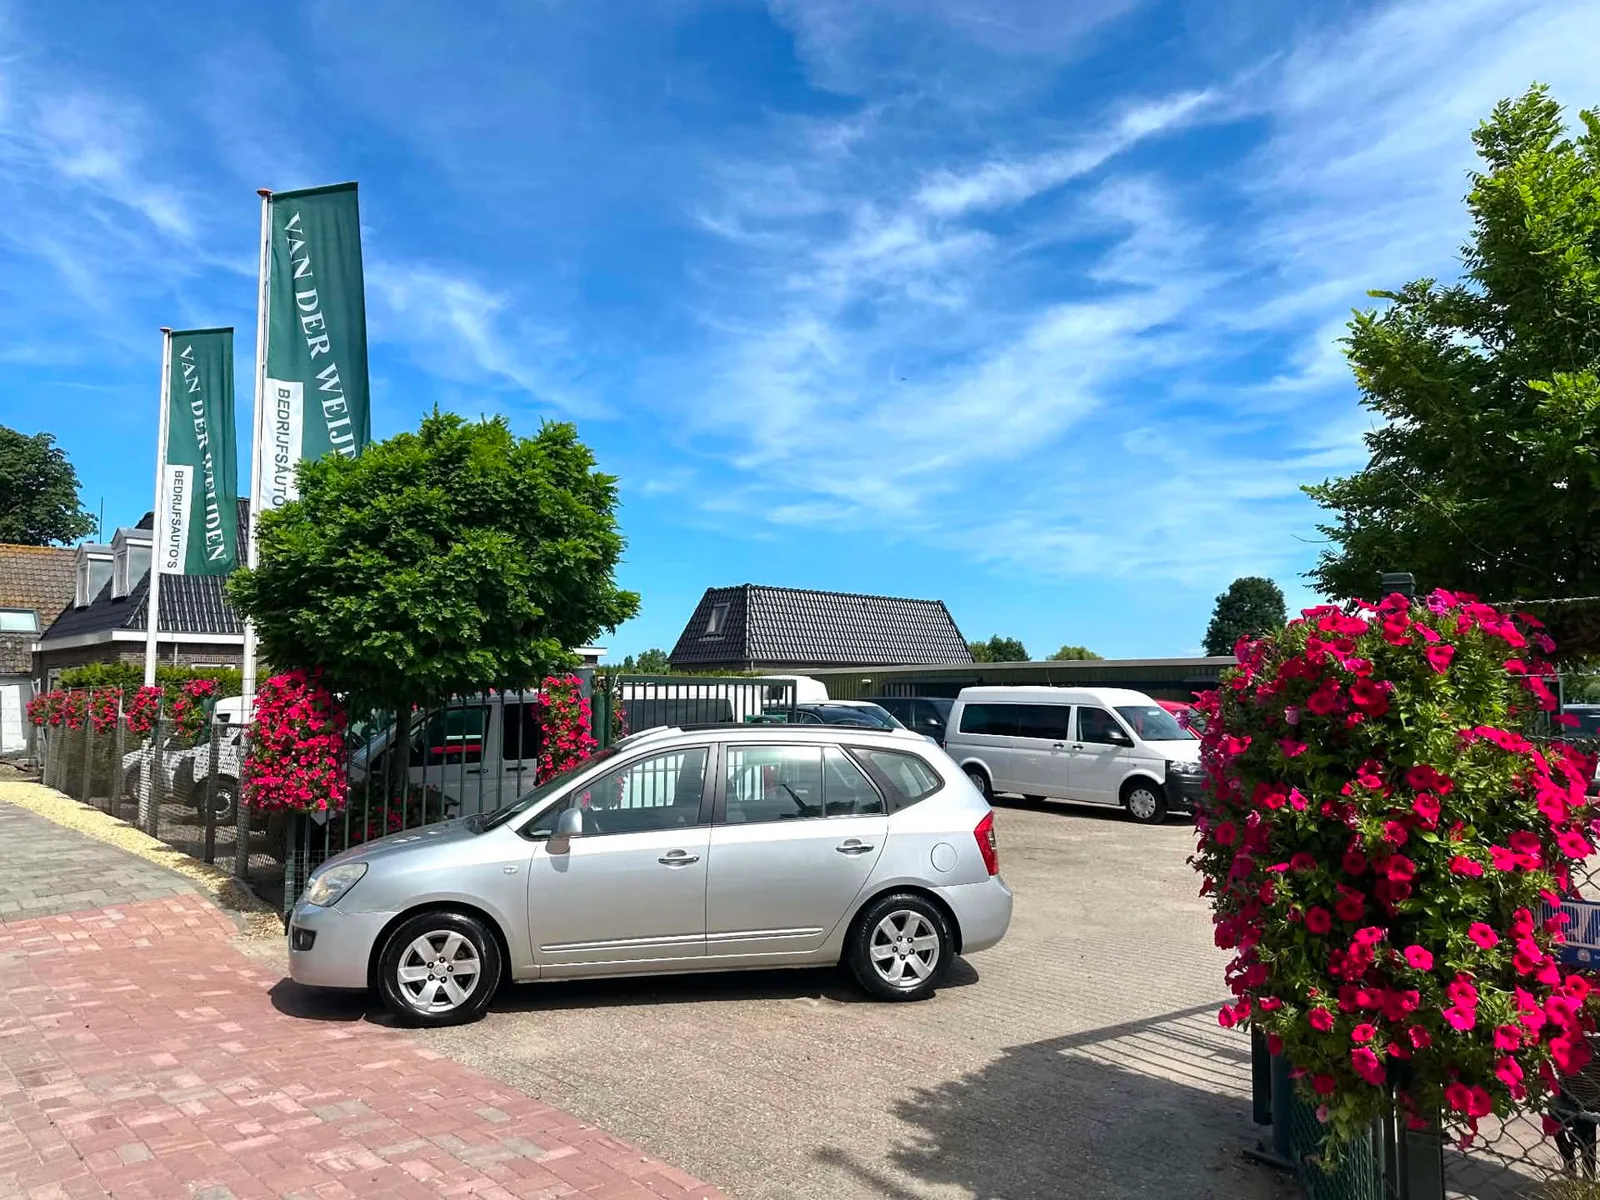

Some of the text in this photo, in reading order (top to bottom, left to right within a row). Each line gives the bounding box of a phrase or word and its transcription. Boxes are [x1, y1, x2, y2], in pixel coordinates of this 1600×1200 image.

[284, 211, 313, 279] VAN
[295, 287, 331, 360] DER
[180, 344, 201, 393] VAN
[191, 400, 209, 450] DER
[167, 470, 184, 569] BEDRIJFSAUTO'S
